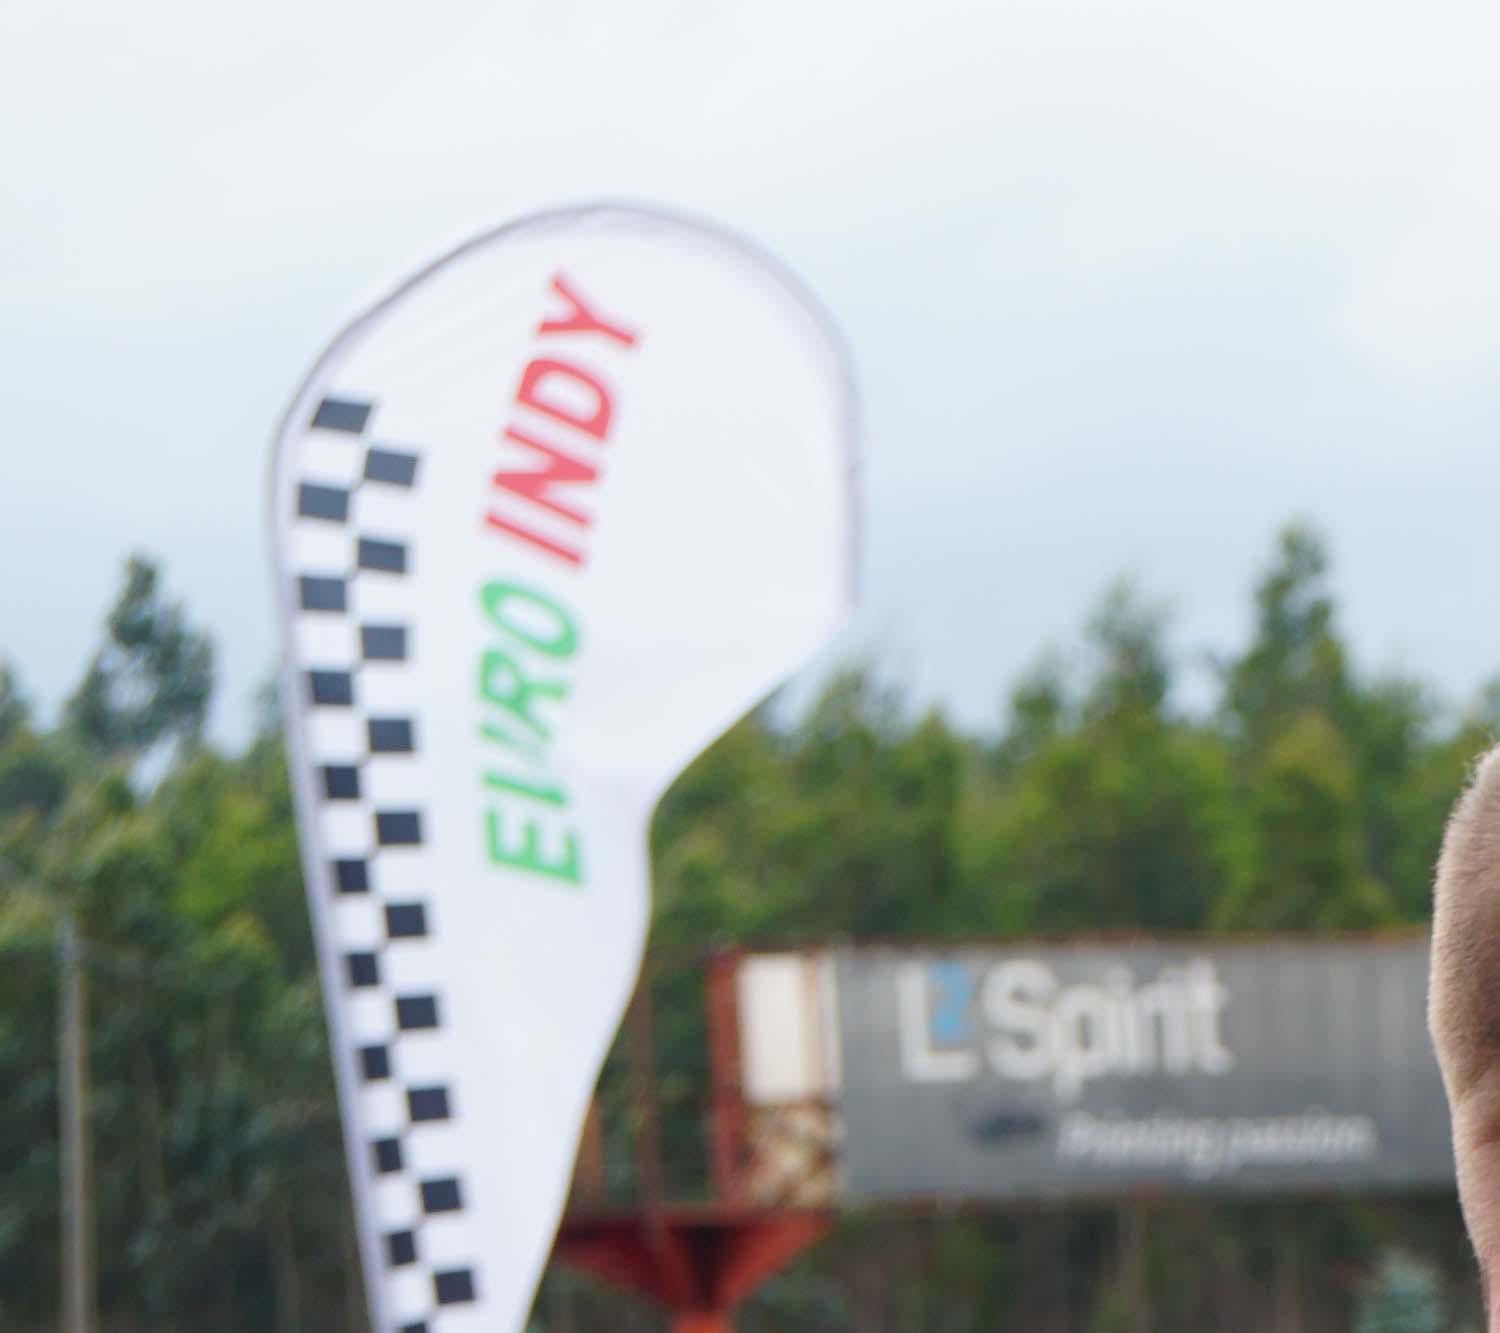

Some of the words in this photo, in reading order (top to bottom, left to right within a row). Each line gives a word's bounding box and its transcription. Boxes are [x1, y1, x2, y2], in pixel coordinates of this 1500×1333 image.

[483, 273, 639, 569] INDY
[475, 576, 586, 887] EURO
[983, 958, 1236, 1101] Spirit
